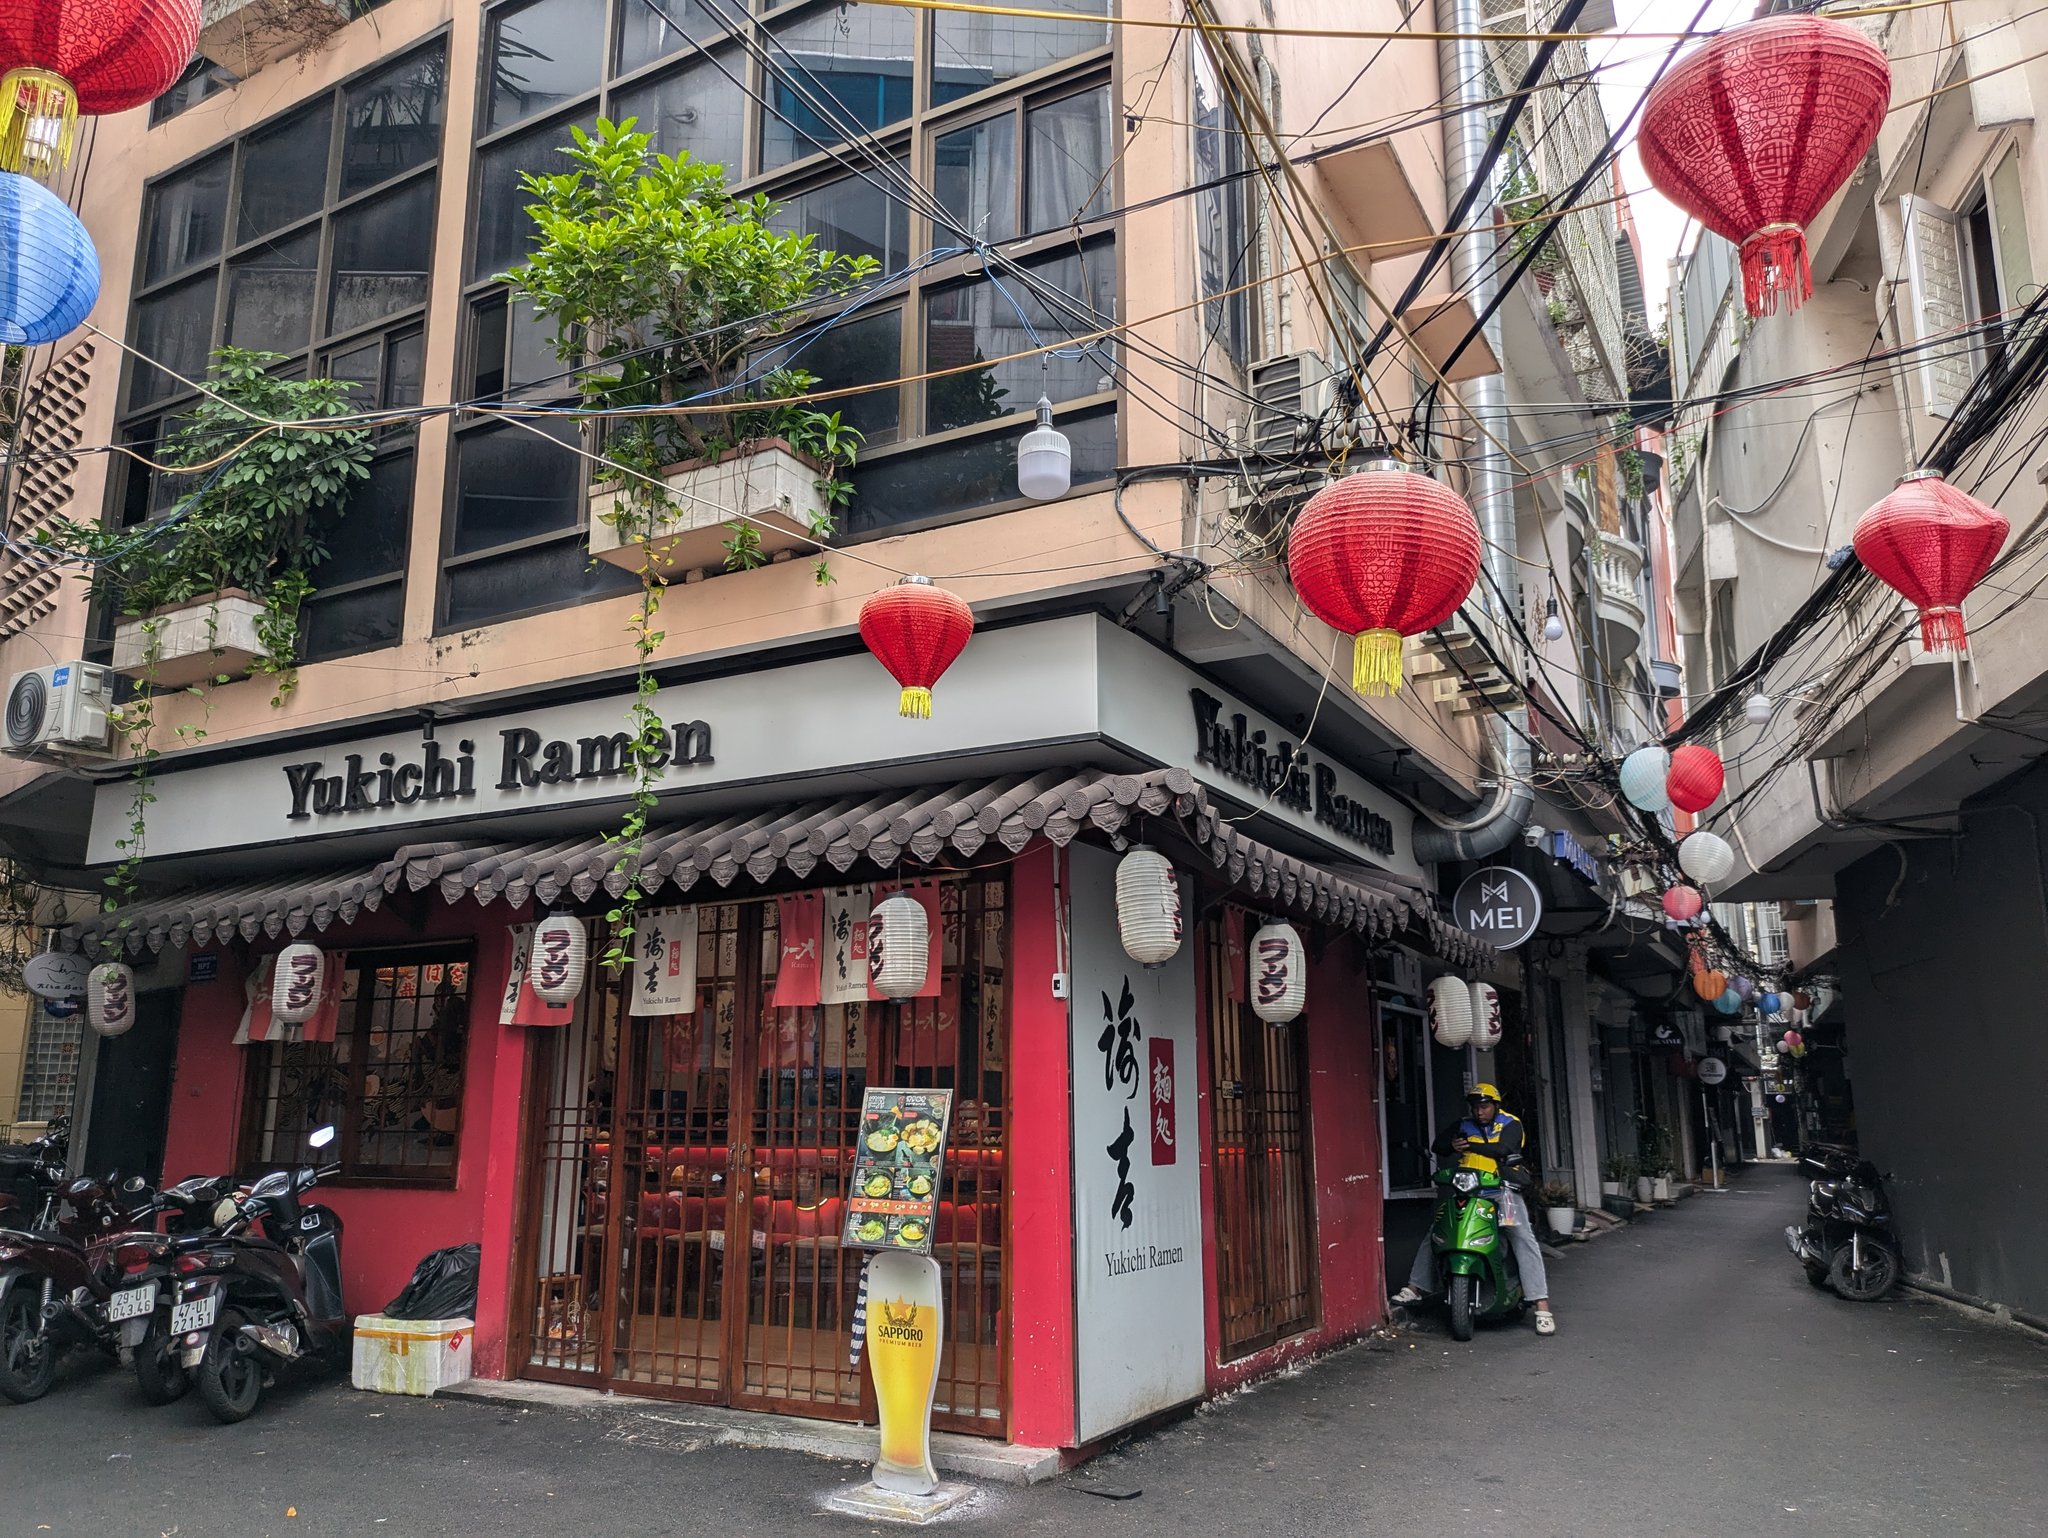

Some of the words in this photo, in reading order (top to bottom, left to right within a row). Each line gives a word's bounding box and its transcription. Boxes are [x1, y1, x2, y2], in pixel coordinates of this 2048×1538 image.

[1189, 687, 1312, 812] Yukichi
[283, 739, 476, 819] Yukichi
[1470, 906, 1523, 931] MEI
[1105, 1245, 1146, 1277] Yukichi
[1149, 1244, 1183, 1270] Ramen
[117, 1287, 148, 1306] 29-U1
[113, 1300, 151, 1320] 043.46
[179, 1299, 208, 1318] 47-U1
[173, 1311, 211, 1334] 221.51
[878, 1324, 923, 1342] SAPPORO
[879, 1338, 906, 1347] PREMIUM
